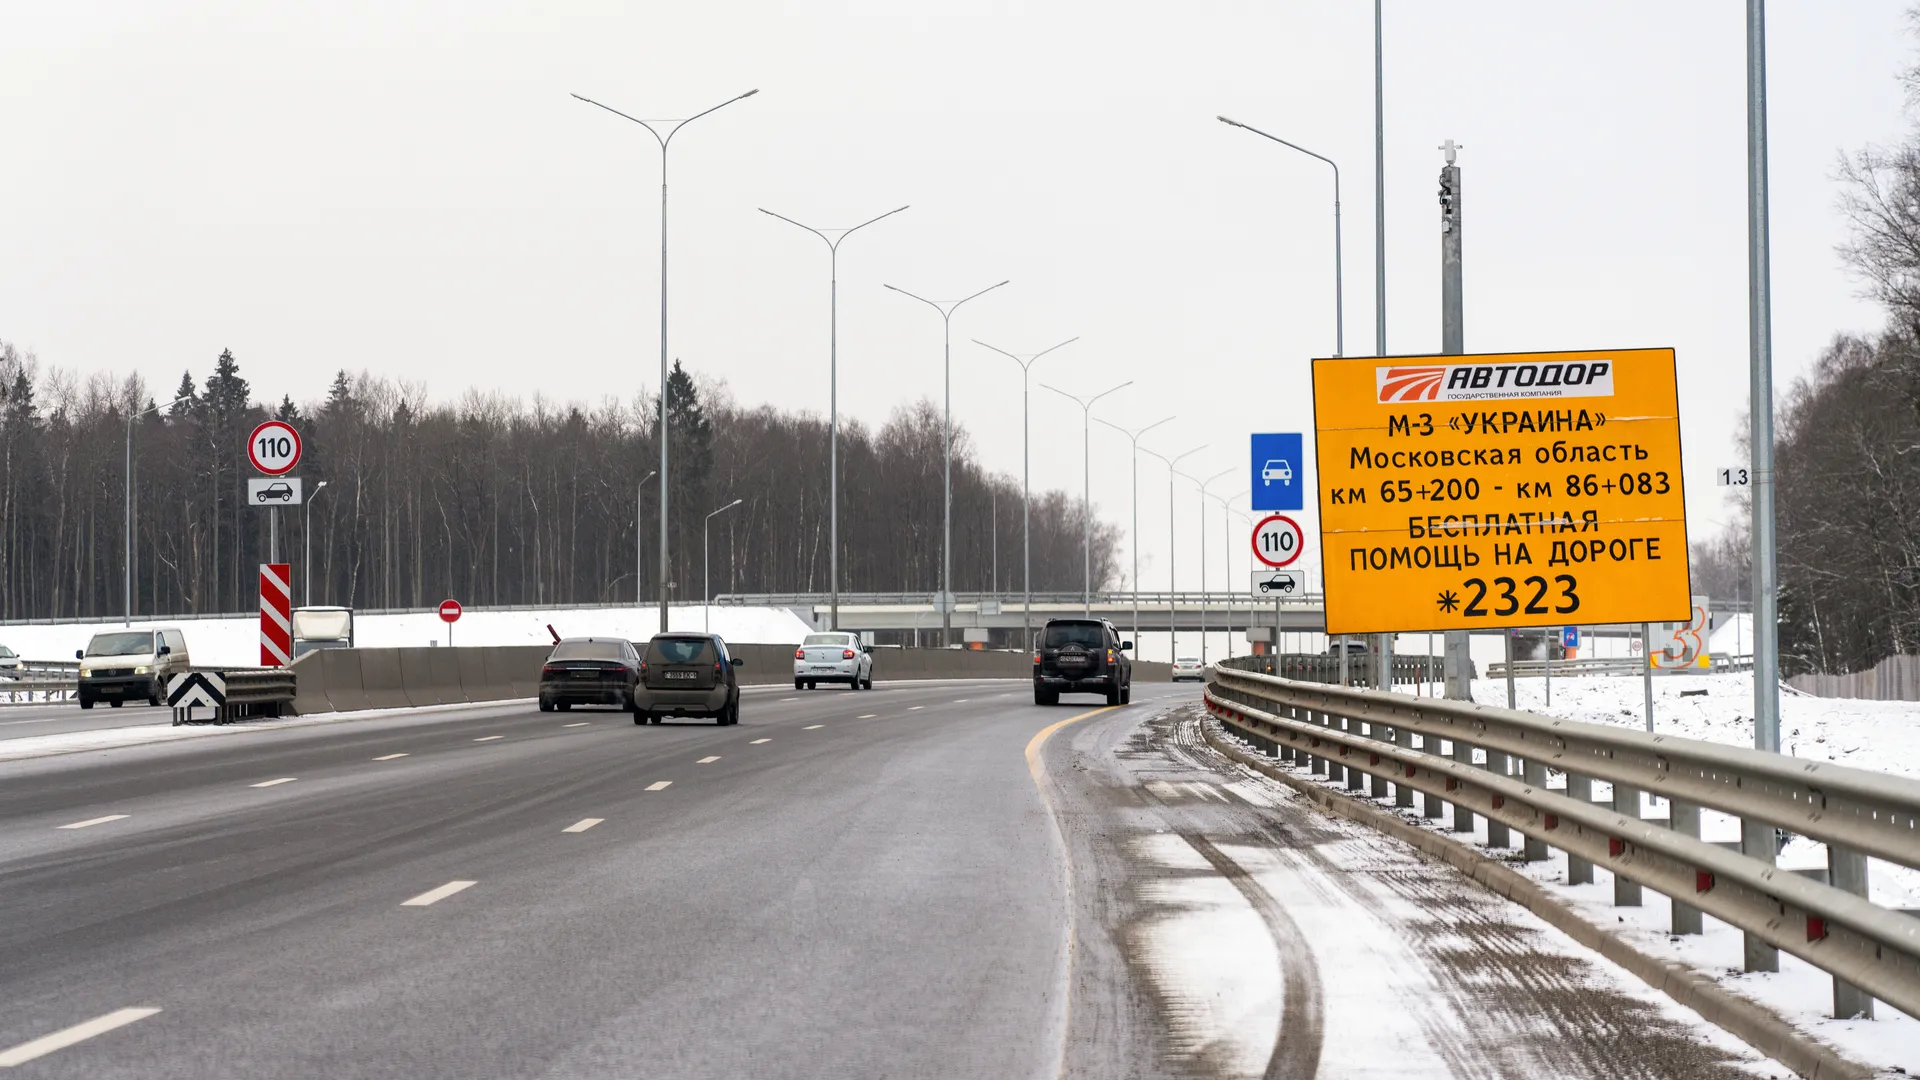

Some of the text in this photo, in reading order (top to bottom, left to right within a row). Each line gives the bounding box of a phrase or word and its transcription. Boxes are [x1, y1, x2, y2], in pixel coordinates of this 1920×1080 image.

[1447, 363, 1610, 389] АВТОДОР
[1447, 390, 1562, 400] ГОСУДАРСТВЕННАЯ КОМПАНИЯ
[1388, 409, 1607, 437] М-3 «УКРАИНА»
[258, 438, 291, 458] 110
[1350, 440, 1649, 469] Московская область
[1331, 487, 1366, 504] км
[1380, 478, 1481, 503] 65+200
[1517, 481, 1552, 498] км
[1566, 471, 1671, 497] 86+083
[1722, 469, 1748, 485] 1.3
[1408, 510, 1599, 539] БЕСПЛАТНАЯ
[1261, 531, 1294, 552] 110
[1350, 537, 1662, 571] ПОМОЩЬ НА ДОРОГЕ
